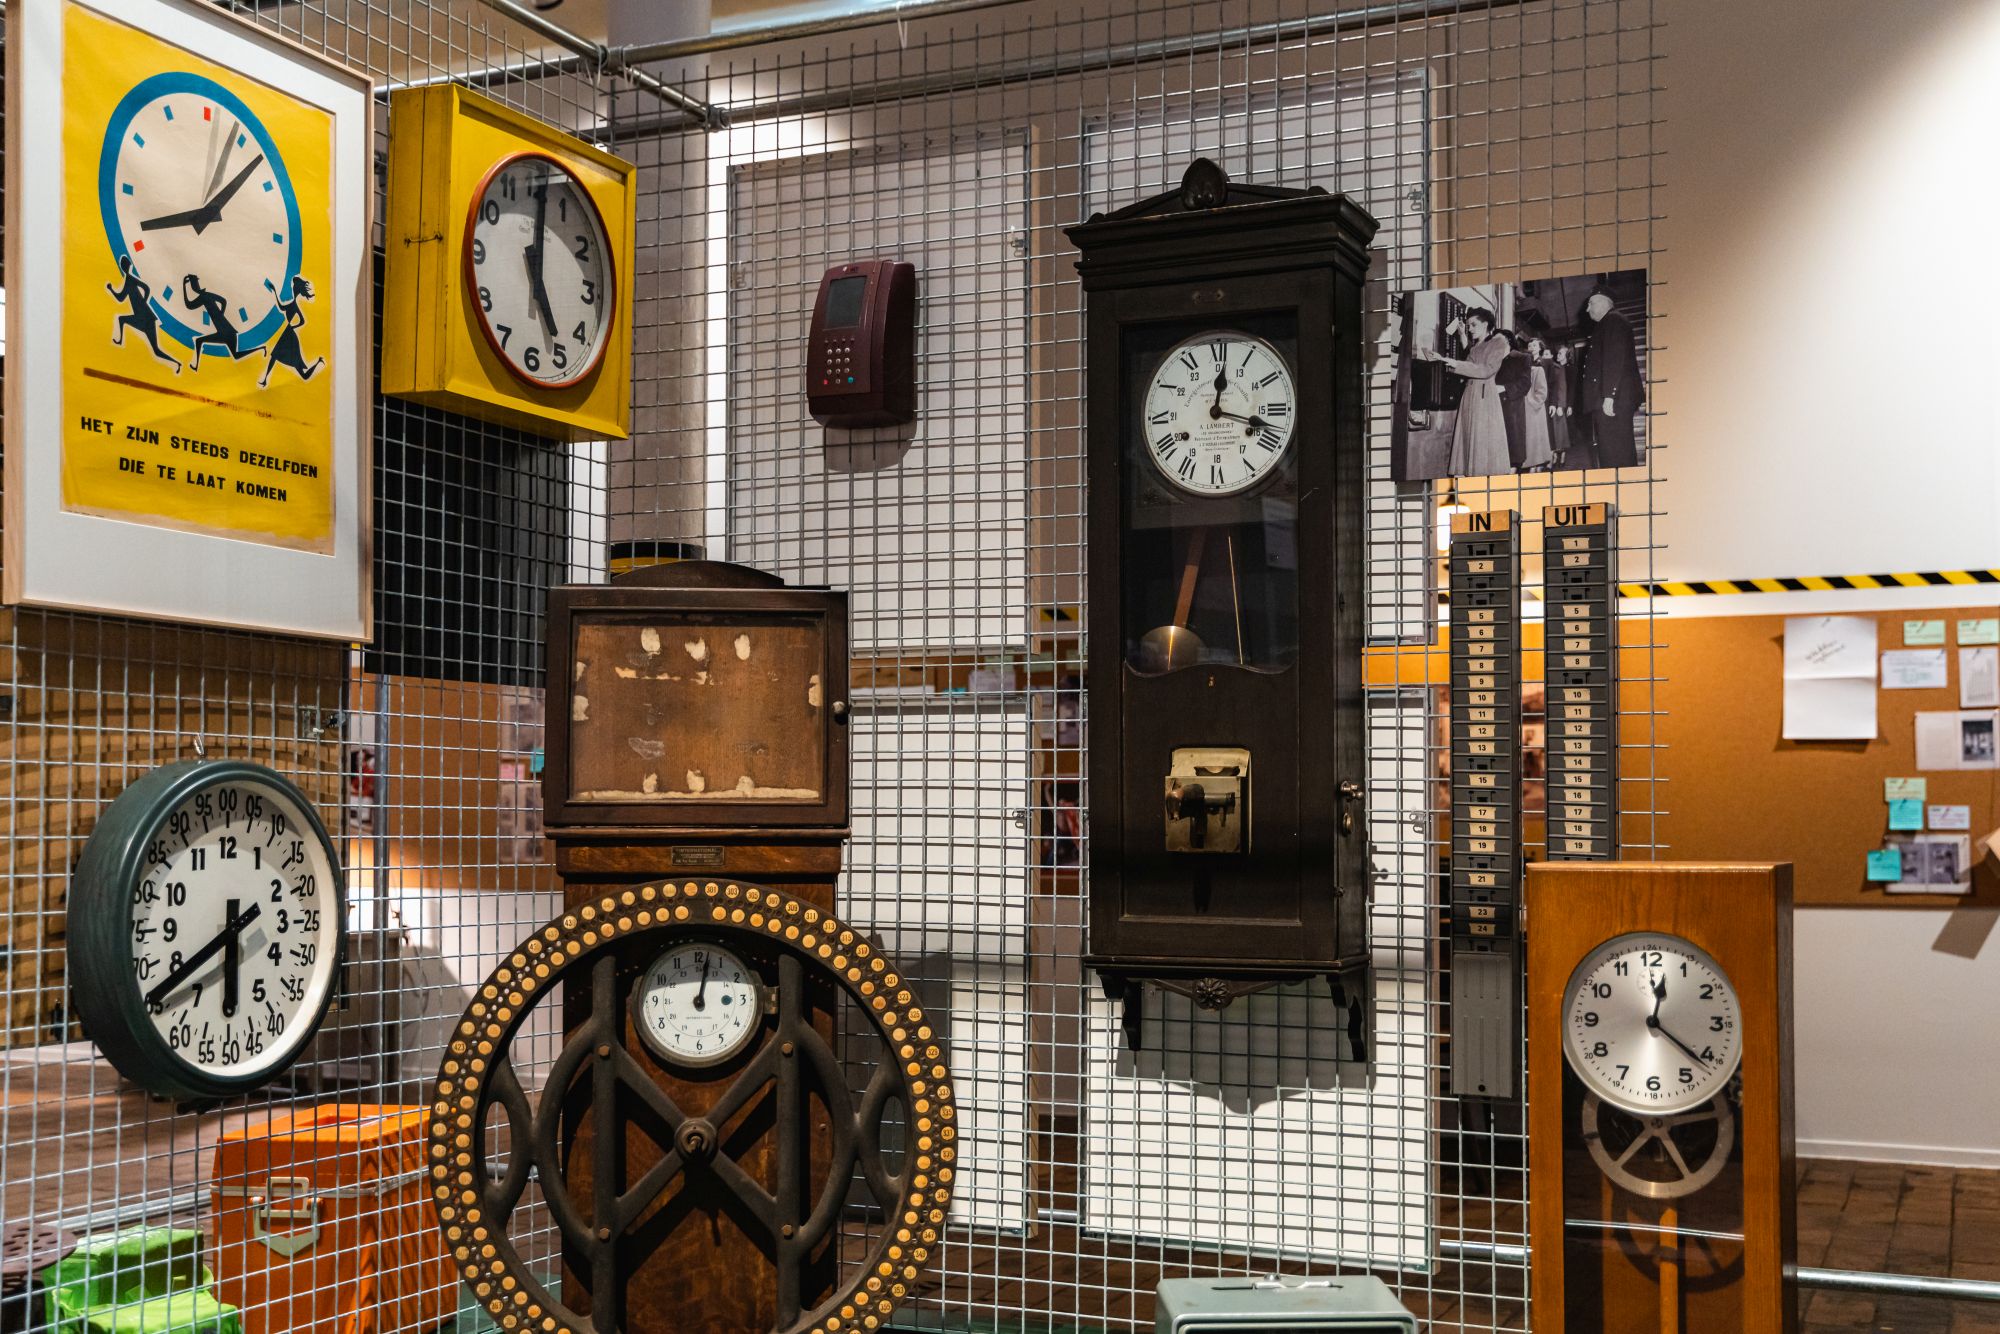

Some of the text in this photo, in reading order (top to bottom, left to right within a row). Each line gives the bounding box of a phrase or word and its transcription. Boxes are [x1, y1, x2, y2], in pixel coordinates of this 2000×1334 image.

[500, 172, 516, 201] 11
[559, 198, 566, 222] 1
[473, 238, 486, 265] 9
[575, 236, 589, 262] 2
[479, 286, 493, 313] 8
[581, 279, 595, 305] 3
[496, 324, 512, 351] 7
[573, 321, 586, 345] 4
[524, 347, 540, 372] 6
[552, 343, 567, 369] 5
[1243, 349, 1254, 367] I
[1190, 372, 1199, 381] 23
[1236, 368, 1244, 377] 13
[1259, 371, 1279, 387] II
[1177, 388, 1185, 396] 22
[1252, 382, 1259, 391] 14
[1170, 412, 1177, 420] 21
[1259, 406, 1265, 415] 15
[1268, 403, 1286, 416] III
[1253, 427, 1261, 437] 16
[81, 416, 318, 478] HET ZIJN STEEDS DEZELFDEN
[1189, 448, 1196, 457] 19
[1239, 445, 1246, 454] 17
[1214, 454, 1221, 463] 18
[119, 457, 287, 502] DIE TE LAAT KOMEN
[1469, 513, 1491, 531] IN
[1555, 506, 1591, 526] UIT
[195, 793, 213, 817] 95
[219, 788, 238, 811] 00
[245, 795, 263, 818] 05
[169, 811, 189, 834] 90
[271, 814, 285, 836] 10
[148, 840, 166, 864] 85
[219, 836, 238, 859] 12
[291, 840, 304, 864] 15
[191, 848, 206, 871] 11
[254, 846, 261, 870] 1
[166, 882, 186, 906] 10
[271, 879, 282, 902] 2
[299, 875, 315, 897] 20
[277, 909, 288, 933] 3
[303, 910, 320, 932] 25
[806, 912, 817, 920] 311
[163, 917, 177, 943] 9
[267, 942, 281, 967] 4
[300, 944, 315, 967] 30
[673, 958, 681, 969] 11
[694, 952, 703, 963] 12
[719, 957, 723, 969] 1
[1640, 952, 1663, 967] 12
[734, 972, 741, 983] 2
[1614, 961, 1628, 976] 11
[1680, 962, 1687, 977] 1
[657, 974, 667, 986] 10
[191, 984, 203, 1008] 7
[252, 979, 265, 1003] 5
[289, 978, 304, 1001] 35
[898, 993, 910, 1001] 323
[1592, 984, 1612, 999] 10
[1699, 984, 1713, 1000] 2
[652, 996, 658, 1007] 9
[740, 995, 746, 1006] 3
[267, 1013, 284, 1037] 40
[658, 1018, 665, 1029] 8
[734, 1016, 740, 1028] 4
[1584, 1012, 1599, 1027] 9
[1709, 1017, 1724, 1032] 3
[169, 1024, 190, 1050] 60
[245, 1032, 263, 1056] 45
[675, 1034, 681, 1044] 7
[697, 1039, 703, 1050] 6
[719, 1033, 724, 1044] 5
[198, 1040, 215, 1064] 55
[222, 1042, 240, 1065] 50
[454, 1043, 465, 1051] 423
[1594, 1042, 1608, 1057] 8
[1700, 1046, 1714, 1062] 4
[1616, 1065, 1630, 1080] 7
[1678, 1068, 1693, 1084] 5
[1646, 1076, 1661, 1091] 6
[893, 1286, 904, 1294] 353
